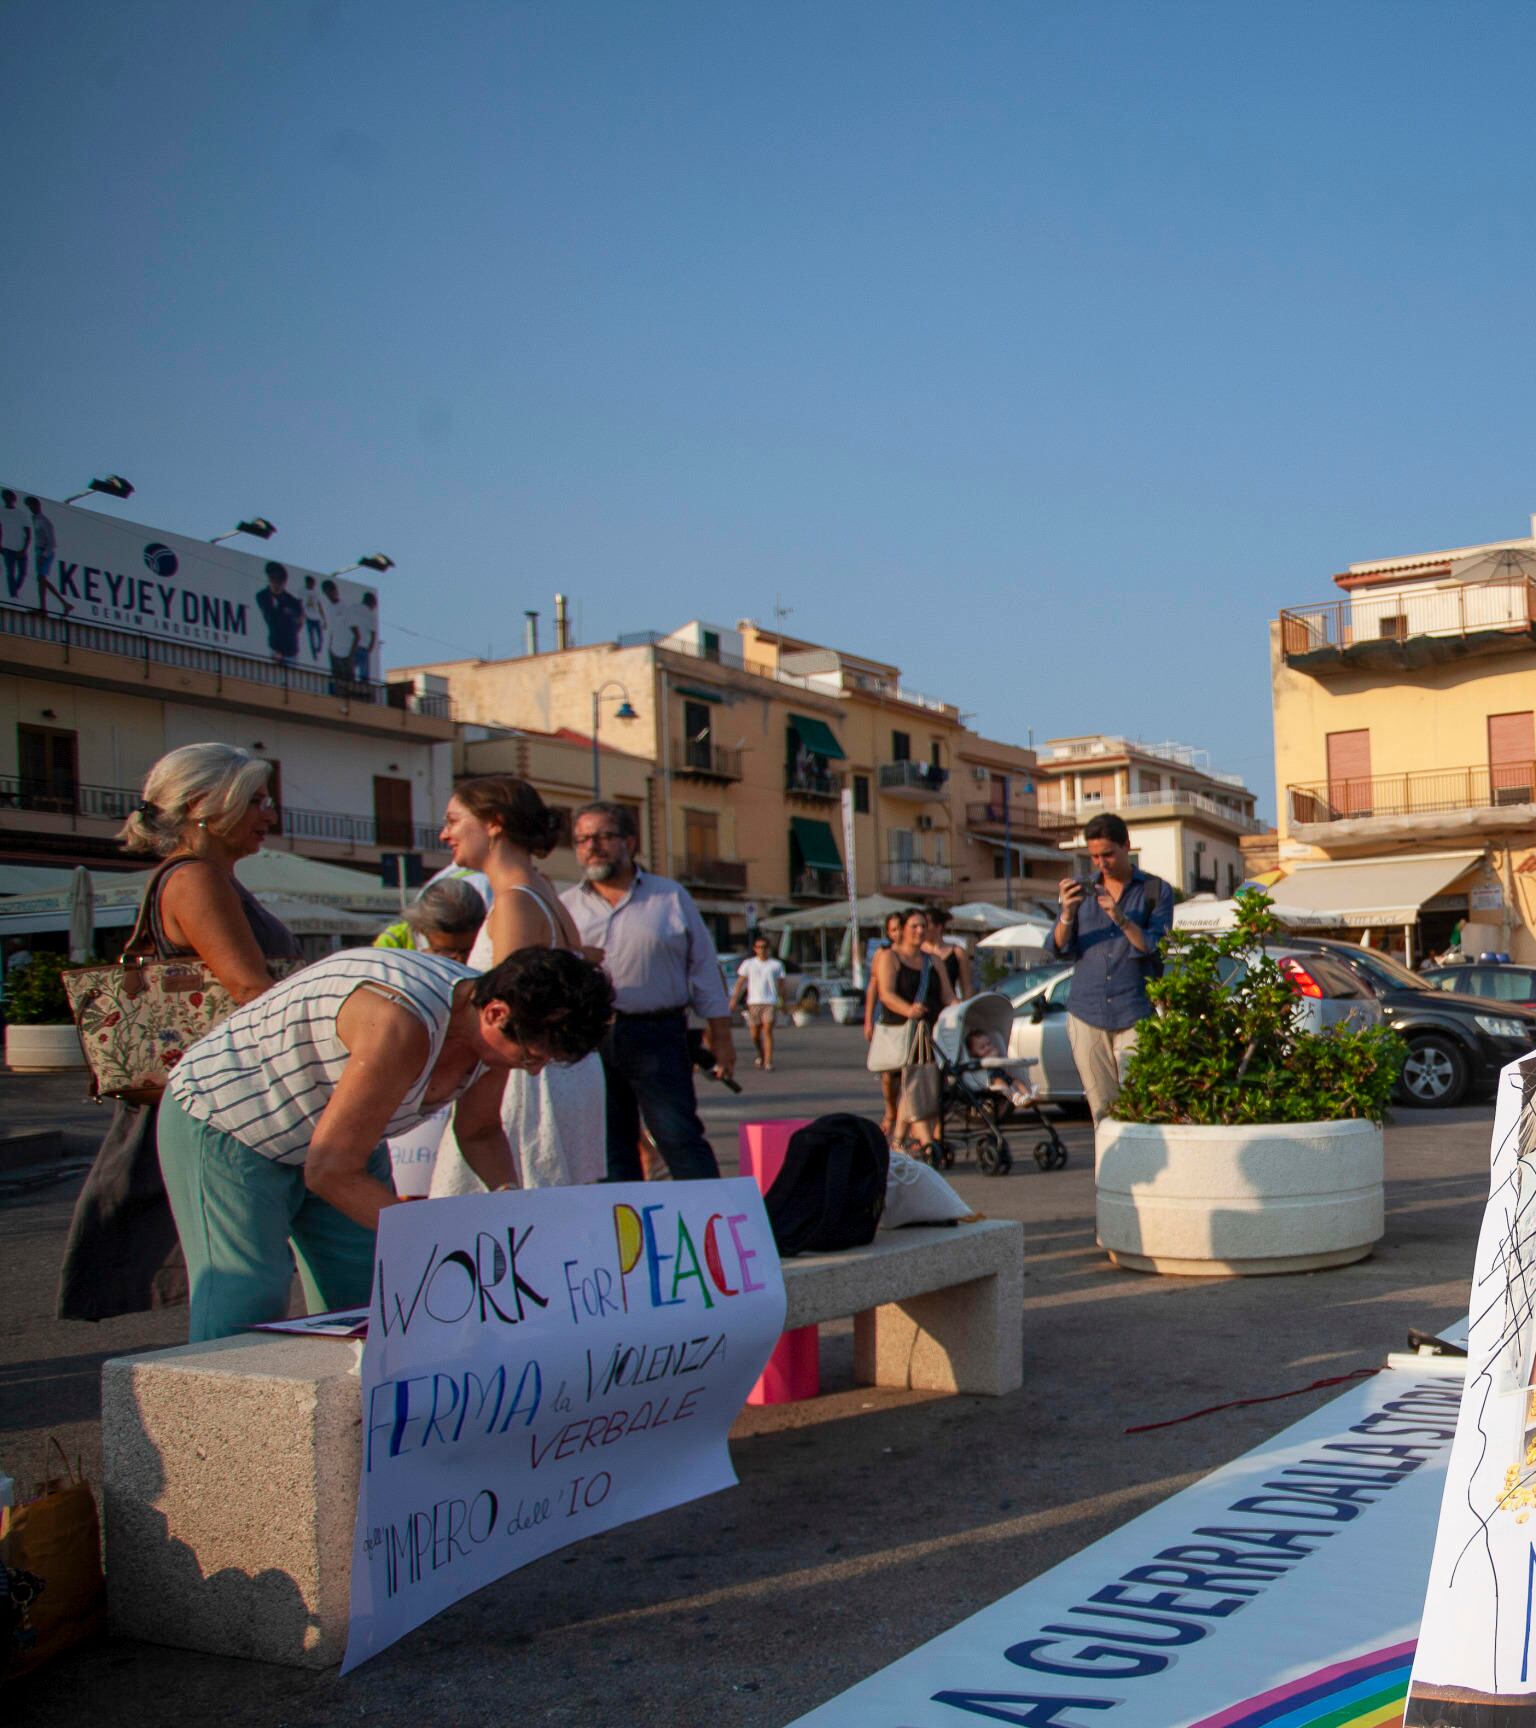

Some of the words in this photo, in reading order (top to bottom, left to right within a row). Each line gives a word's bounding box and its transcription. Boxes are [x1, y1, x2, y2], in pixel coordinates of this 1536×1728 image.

[58, 560, 175, 620] KEYJEY
[182, 589, 247, 636] DNM
[378, 1224, 549, 1337] WORK
[612, 1203, 766, 1314] PEACE
[366, 1359, 543, 1474] FERMA
[551, 1380, 573, 1414] la
[529, 1386, 707, 1470] VERBALE
[1003, 1526, 1335, 1679] GUERRA
[1227, 1444, 1442, 1523] DALLA
